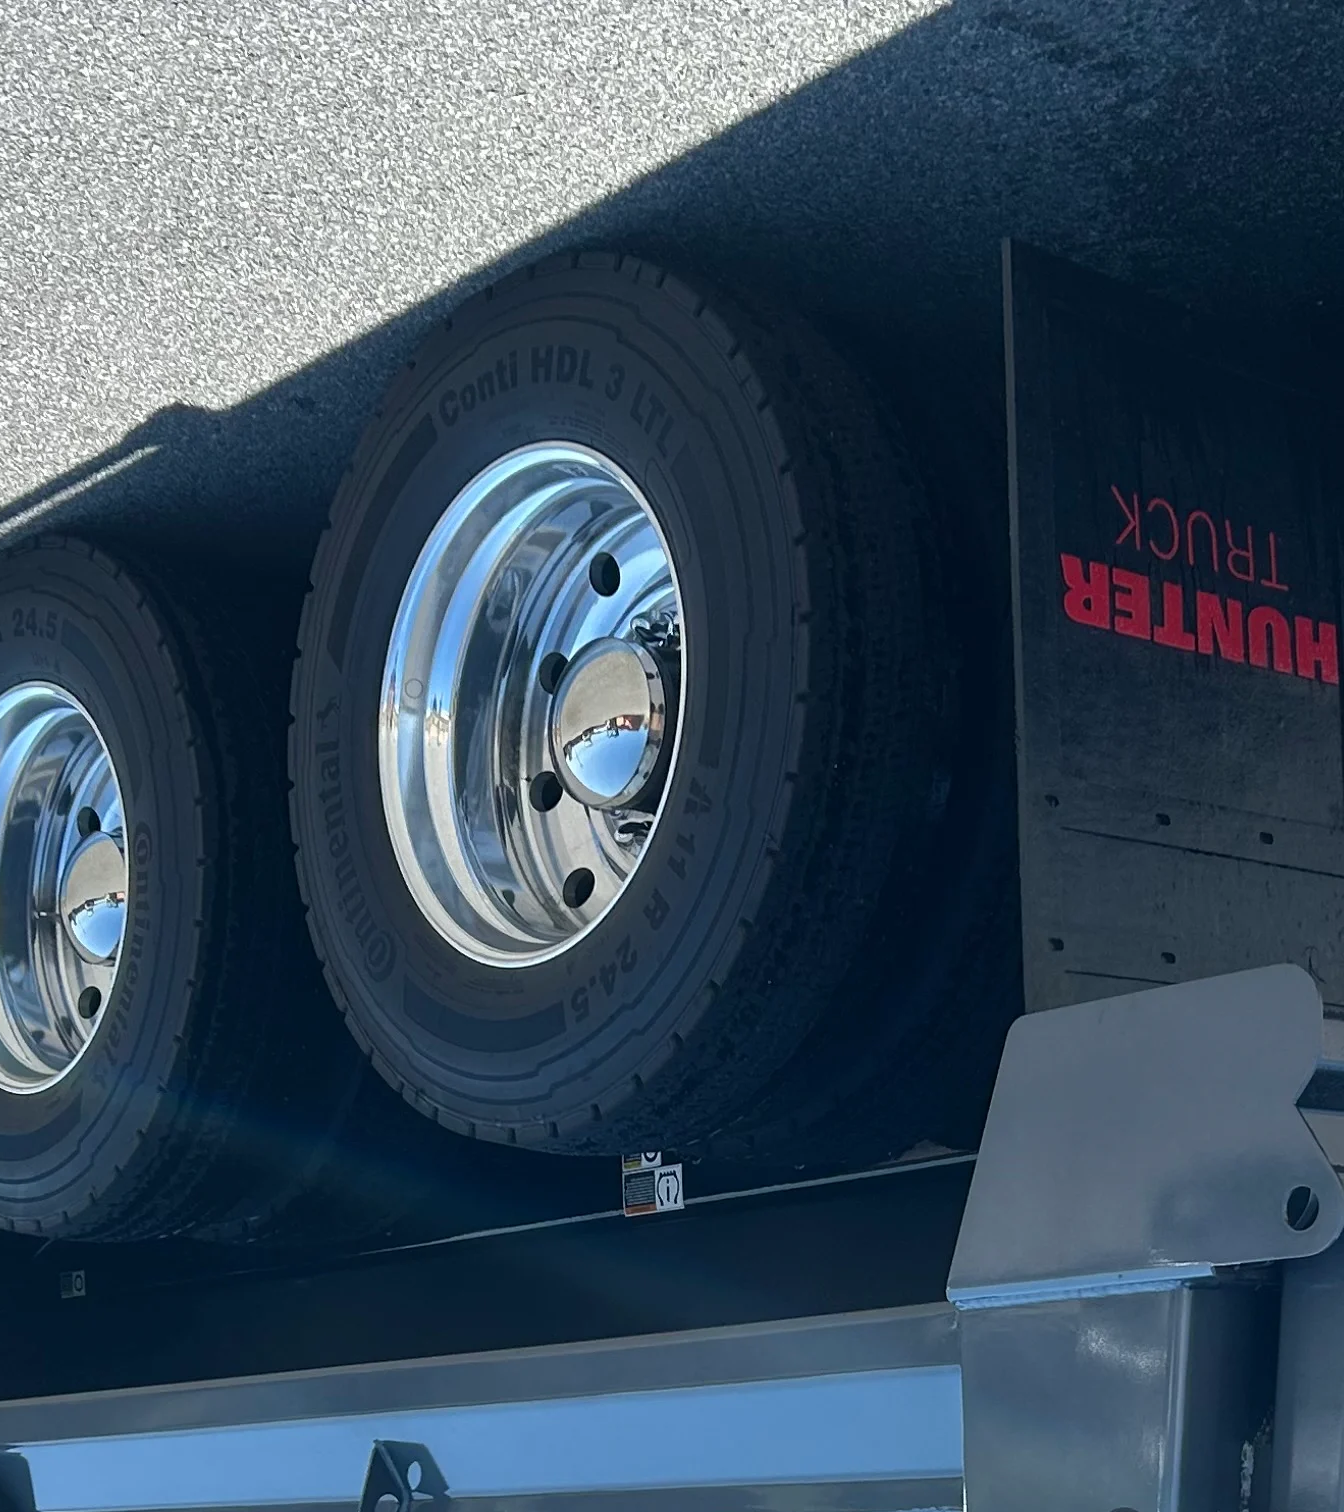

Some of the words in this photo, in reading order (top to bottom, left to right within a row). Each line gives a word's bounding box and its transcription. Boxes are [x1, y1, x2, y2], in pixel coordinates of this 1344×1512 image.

[438, 349, 517, 427] Conti
[530, 344, 594, 390] HDL
[604, 362, 625, 402] 3
[630, 379, 675, 460] LTL
[1109, 484, 1289, 591] TRUCK
[11, 606, 59, 642] 24.5
[1060, 554, 1339, 685] HUNTER
[314, 738, 398, 983] Continental
[642, 887, 670, 931] R
[102, 820, 152, 1067] Continental
[570, 933, 637, 1024] 24.5
